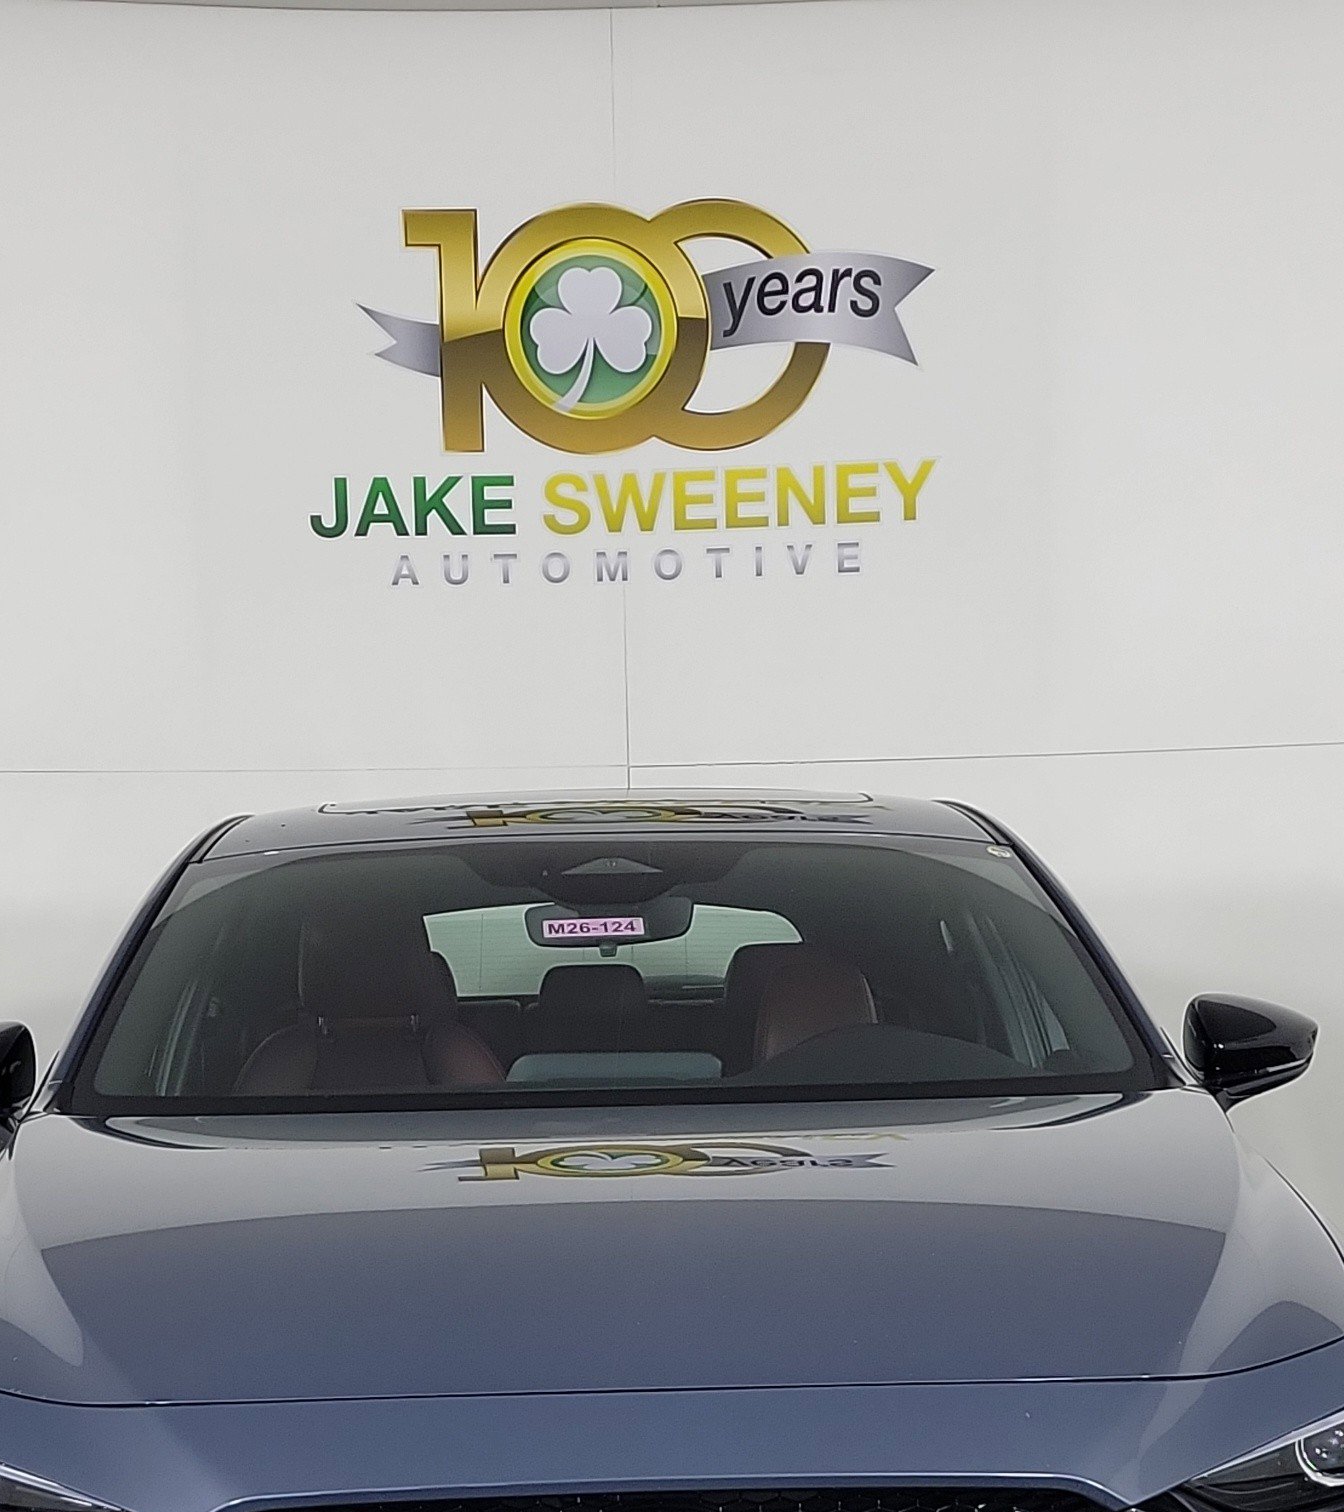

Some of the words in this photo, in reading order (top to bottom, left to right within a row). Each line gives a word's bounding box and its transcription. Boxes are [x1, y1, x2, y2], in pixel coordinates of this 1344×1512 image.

[401, 198, 831, 455] 100
[722, 265, 883, 338] years
[309, 474, 517, 538] JAKE
[542, 458, 937, 535] SWEENEY
[390, 541, 862, 586] AUTOMOTIVE
[547, 921, 637, 935] M26-124
